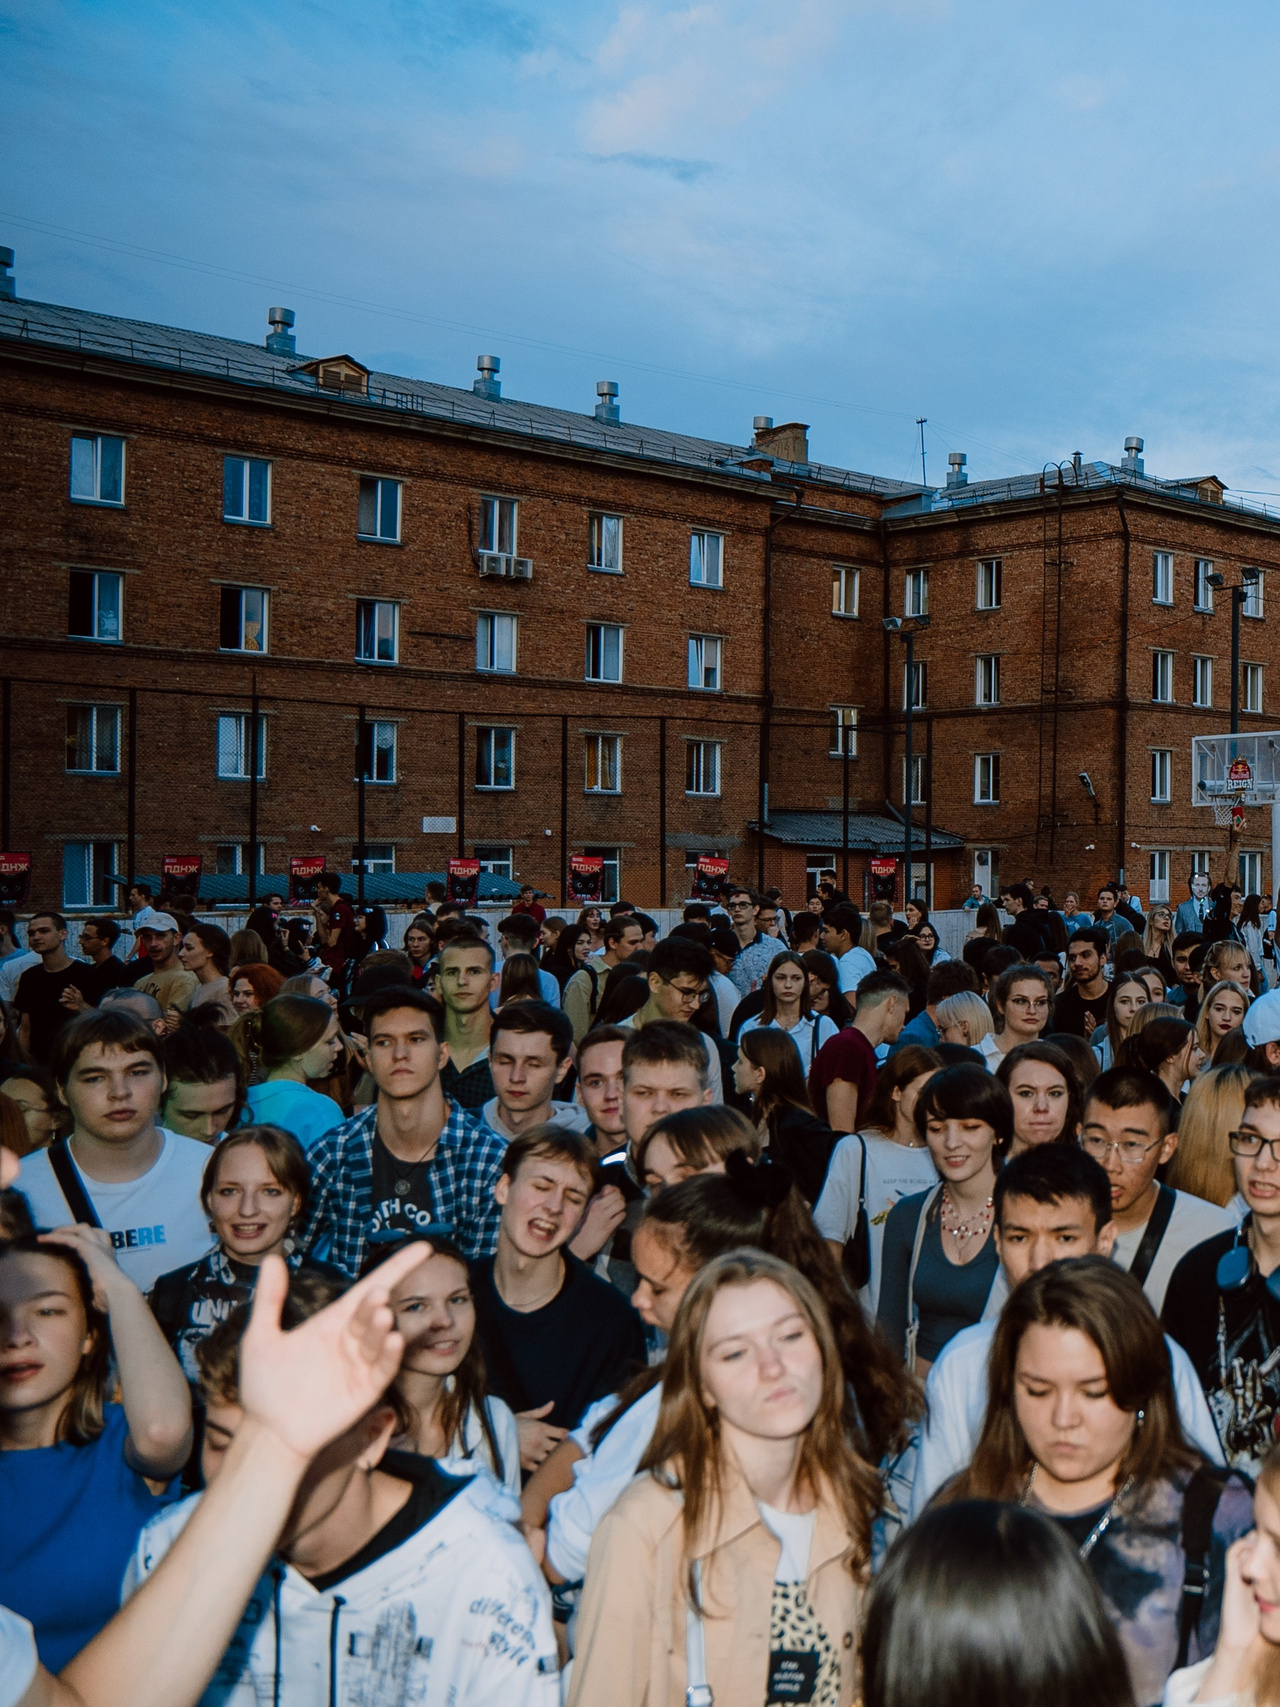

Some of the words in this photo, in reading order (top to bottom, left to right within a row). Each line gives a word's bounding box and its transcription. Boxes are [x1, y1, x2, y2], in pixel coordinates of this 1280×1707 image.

[1227, 778, 1254, 790] REIGN
[0, 863, 28, 872] ДНЖ
[164, 865, 199, 874] ПДНЖ
[292, 866, 324, 875] ПДНЖ
[450, 867, 479, 875] ПДНЖ
[571, 863, 601, 873] ПДНЖ
[698, 864, 727, 874] ПДНЖ
[871, 866, 896, 874] ПДНЖ
